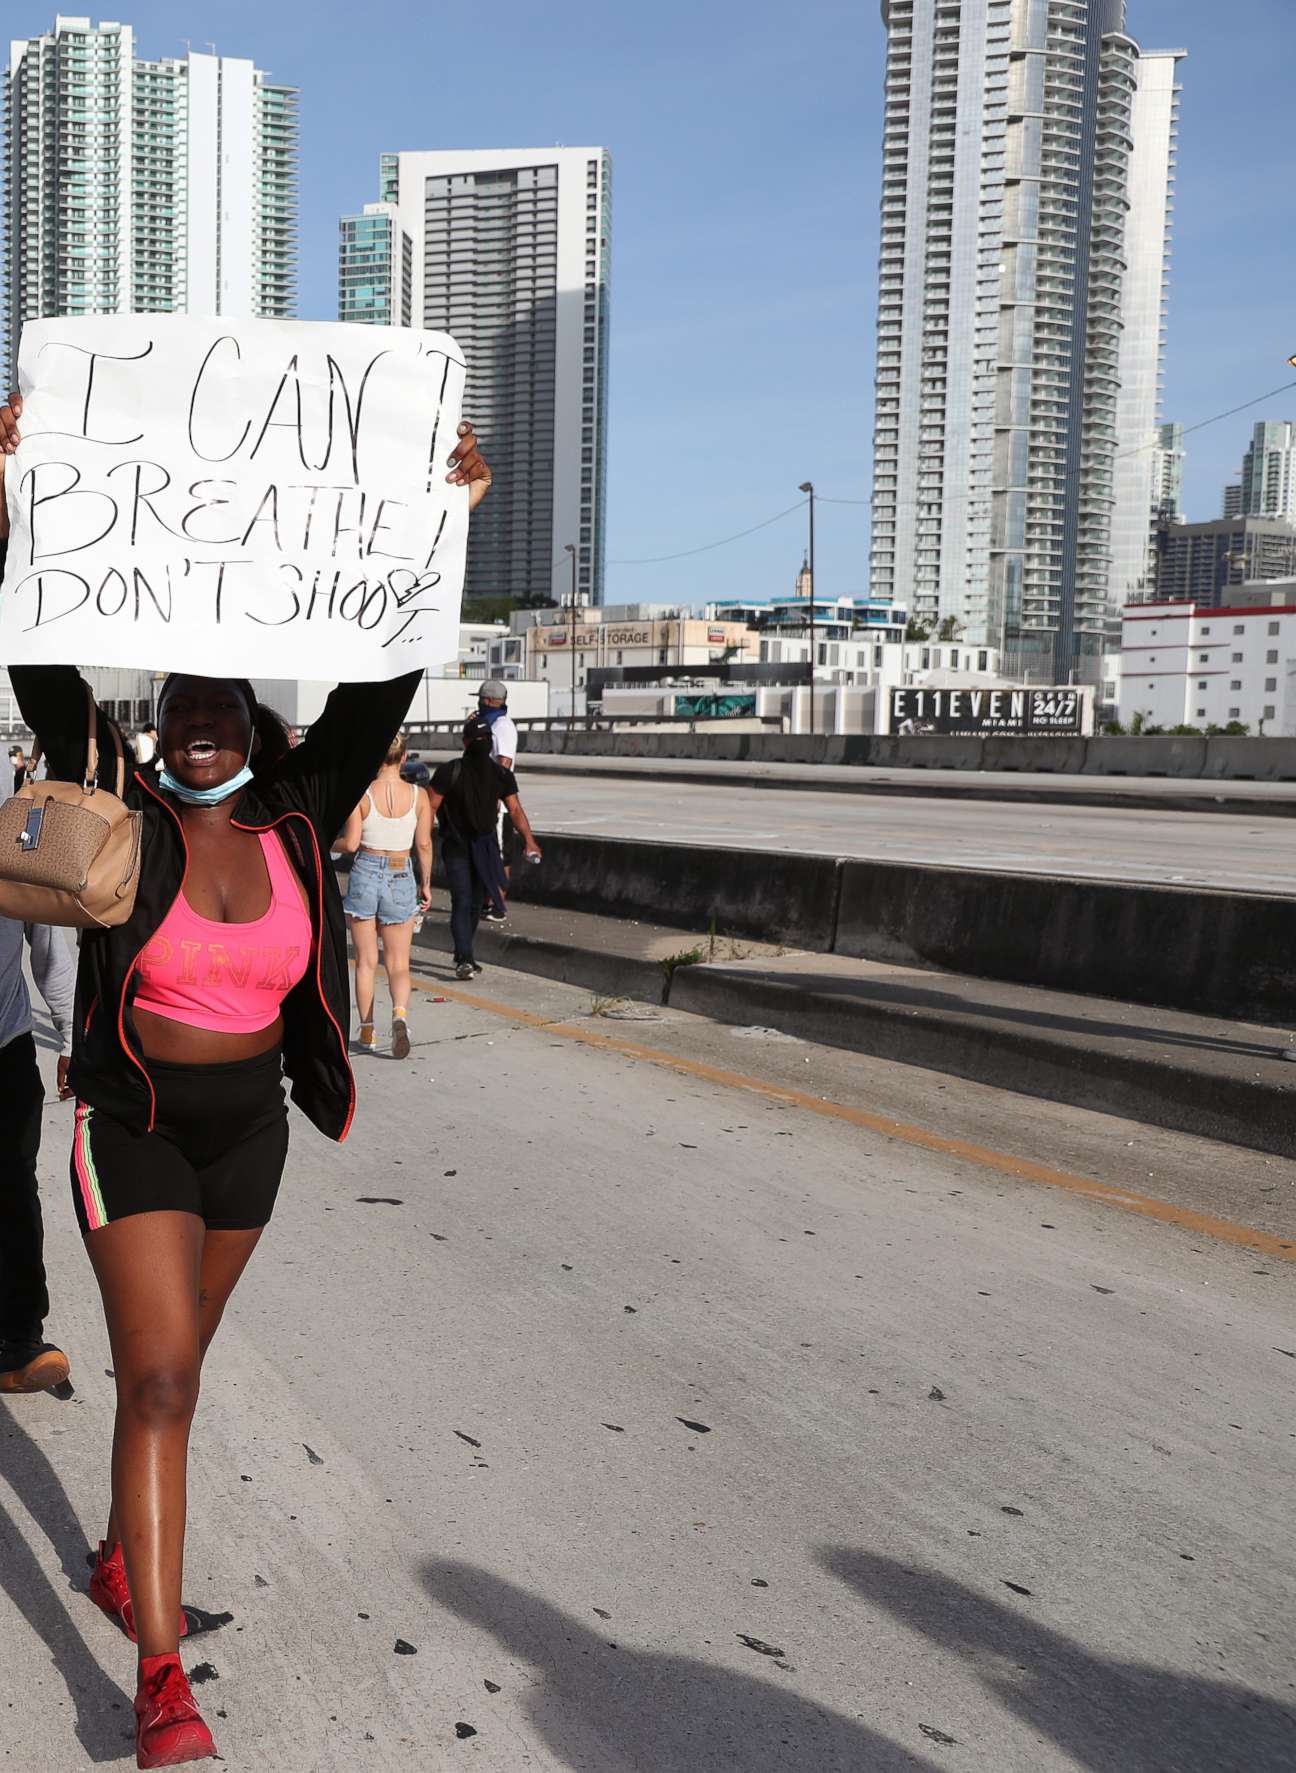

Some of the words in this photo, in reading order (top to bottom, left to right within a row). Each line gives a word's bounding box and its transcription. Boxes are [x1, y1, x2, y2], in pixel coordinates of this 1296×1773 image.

[21, 341, 152, 445] I
[188, 336, 467, 493] CAN'T
[20, 460, 447, 569] BREATHE!
[14, 558, 253, 632] DON'T
[894, 691, 1024, 718] E11EVEN
[1033, 700, 1075, 717] 24/7
[1034, 691, 1076, 700] OPEN
[981, 719, 1024, 727] MIAMI
[138, 935, 300, 991] PINK
